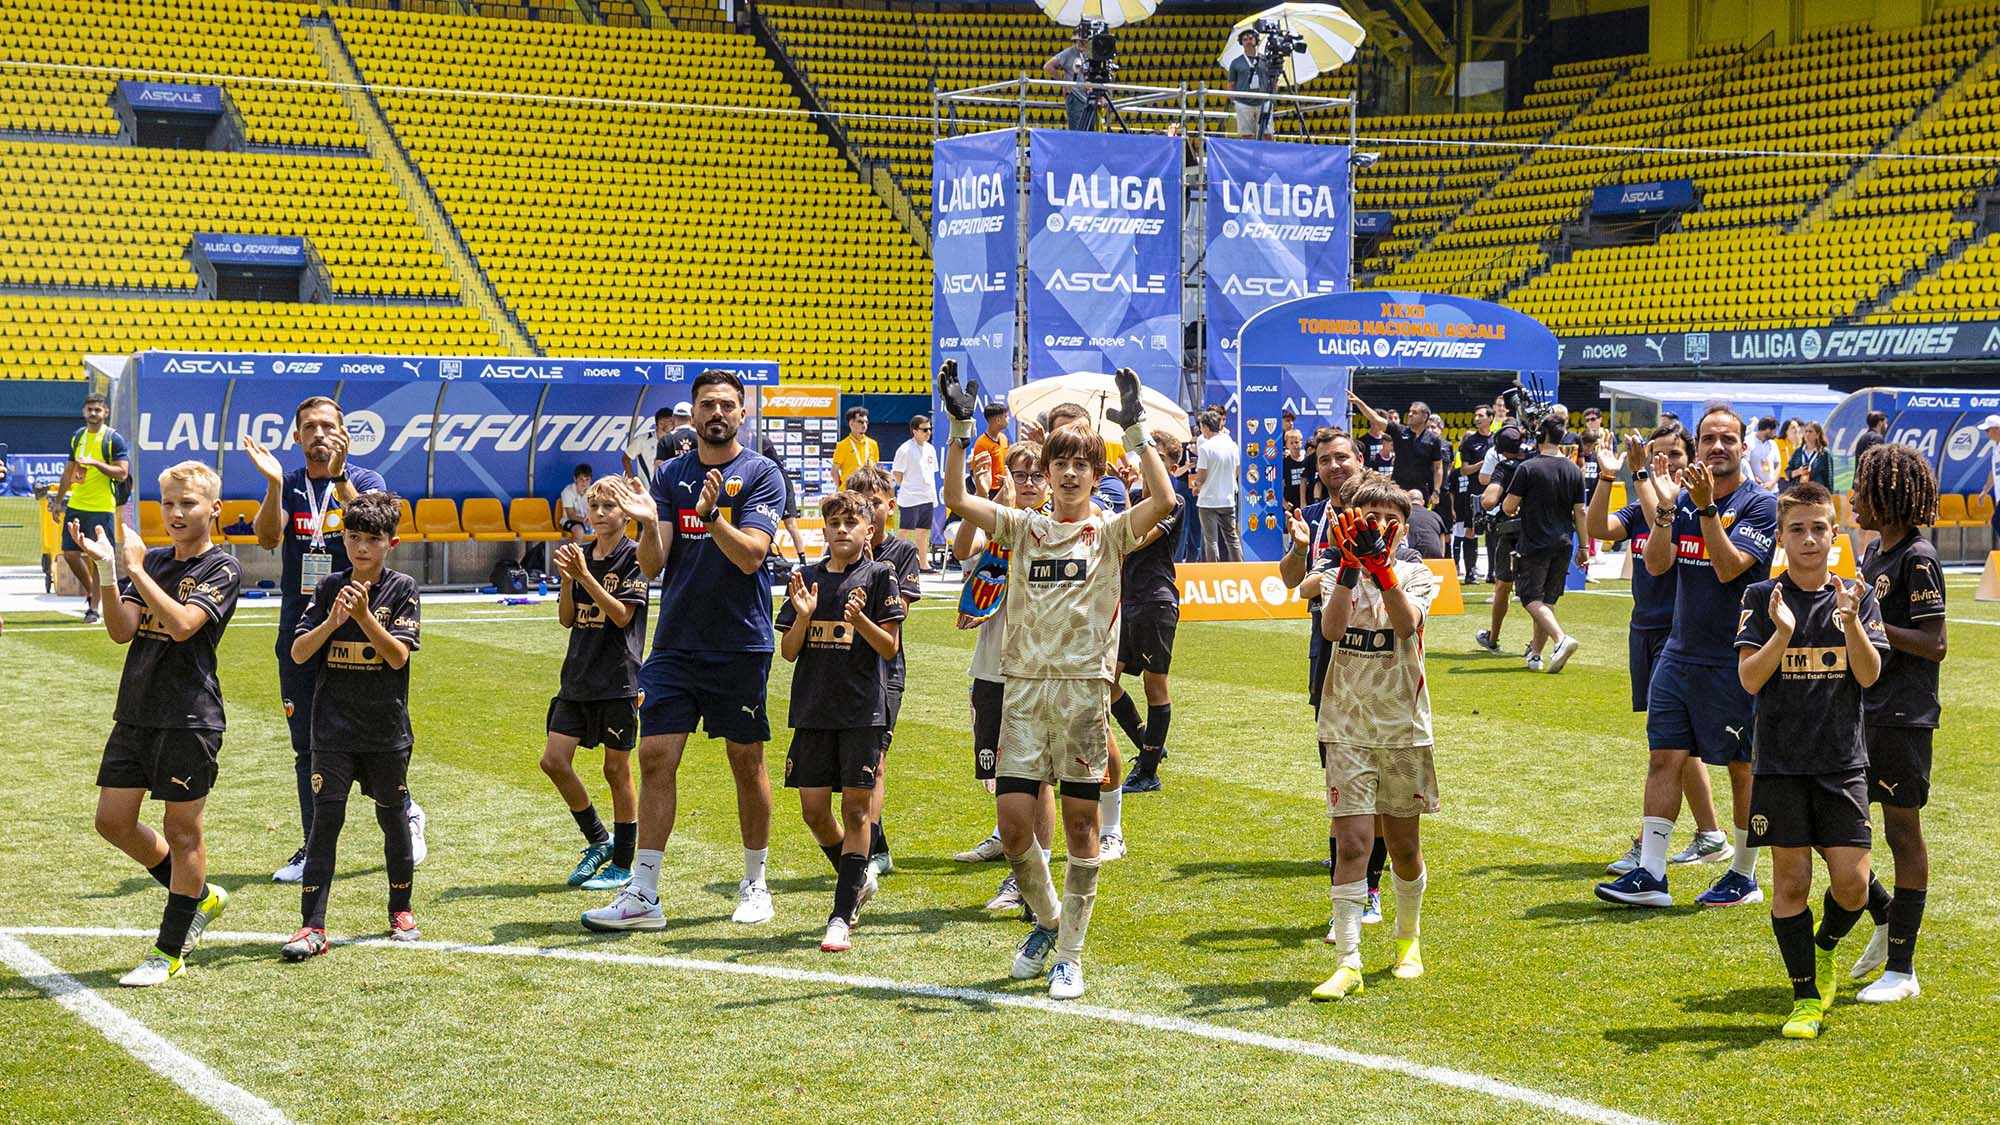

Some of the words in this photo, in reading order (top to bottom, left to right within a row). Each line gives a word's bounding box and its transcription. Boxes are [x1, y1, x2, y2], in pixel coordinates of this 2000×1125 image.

[140, 90, 202, 103] ASCALE
[939, 173, 1005, 212] LALIGA
[1047, 172, 1166, 211] LALIGA
[1621, 190, 1664, 203] ASCALE
[1222, 180, 1335, 218] LALIGA
[204, 242, 231, 252] ALIGA
[943, 272, 1006, 294] ASCALE
[1045, 268, 1165, 293] ASCALE
[1222, 274, 1334, 297] ASCALE
[1299, 318, 1360, 334] TORNEO
[1363, 320, 1441, 337] NACIONAL
[1445, 323, 1505, 339] ASCALE
[1089, 337, 1126, 347] moeve
[1319, 338, 1370, 355] LALIGA
[1731, 333, 1796, 359] LALIGA
[1582, 344, 1628, 360] moeve
[163, 358, 255, 374] ASCALE
[286, 361, 323, 374] FC25
[340, 362, 385, 374] moeve
[480, 363, 564, 379] ASCALE
[583, 368, 621, 378] moeve
[1907, 395, 1961, 408] ASCALE
[27, 462, 65, 475] LALIG
[1680, 540, 1699, 554] TM
[1033, 565, 1050, 577] TM
[1345, 632, 1363, 647] TM
[333, 646, 349, 658] TM
[1786, 654, 1807, 667] TM
